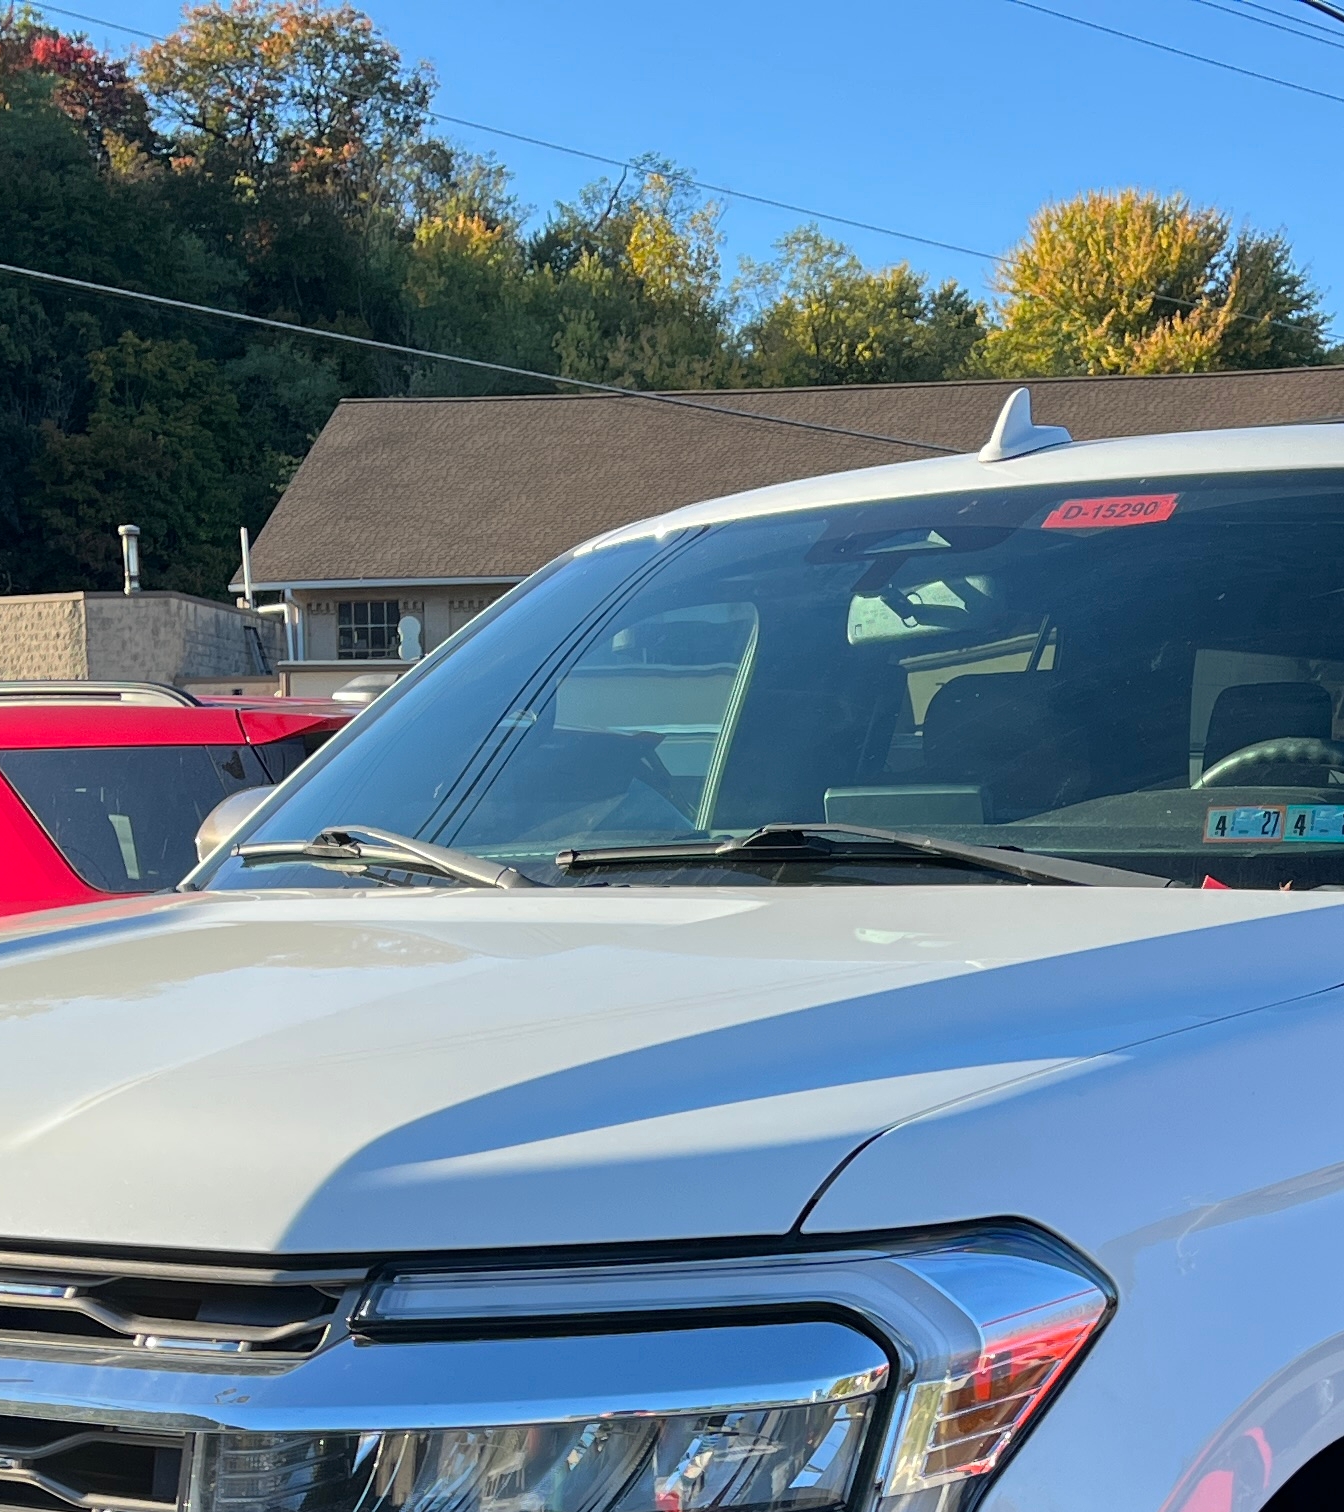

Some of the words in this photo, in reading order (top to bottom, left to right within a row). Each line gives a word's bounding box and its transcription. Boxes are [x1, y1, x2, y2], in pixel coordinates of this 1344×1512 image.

[1062, 501, 1160, 520] D-15290
[1215, 815, 1227, 837] 4
[1261, 810, 1281, 838] 27
[1294, 813, 1306, 837] 4
